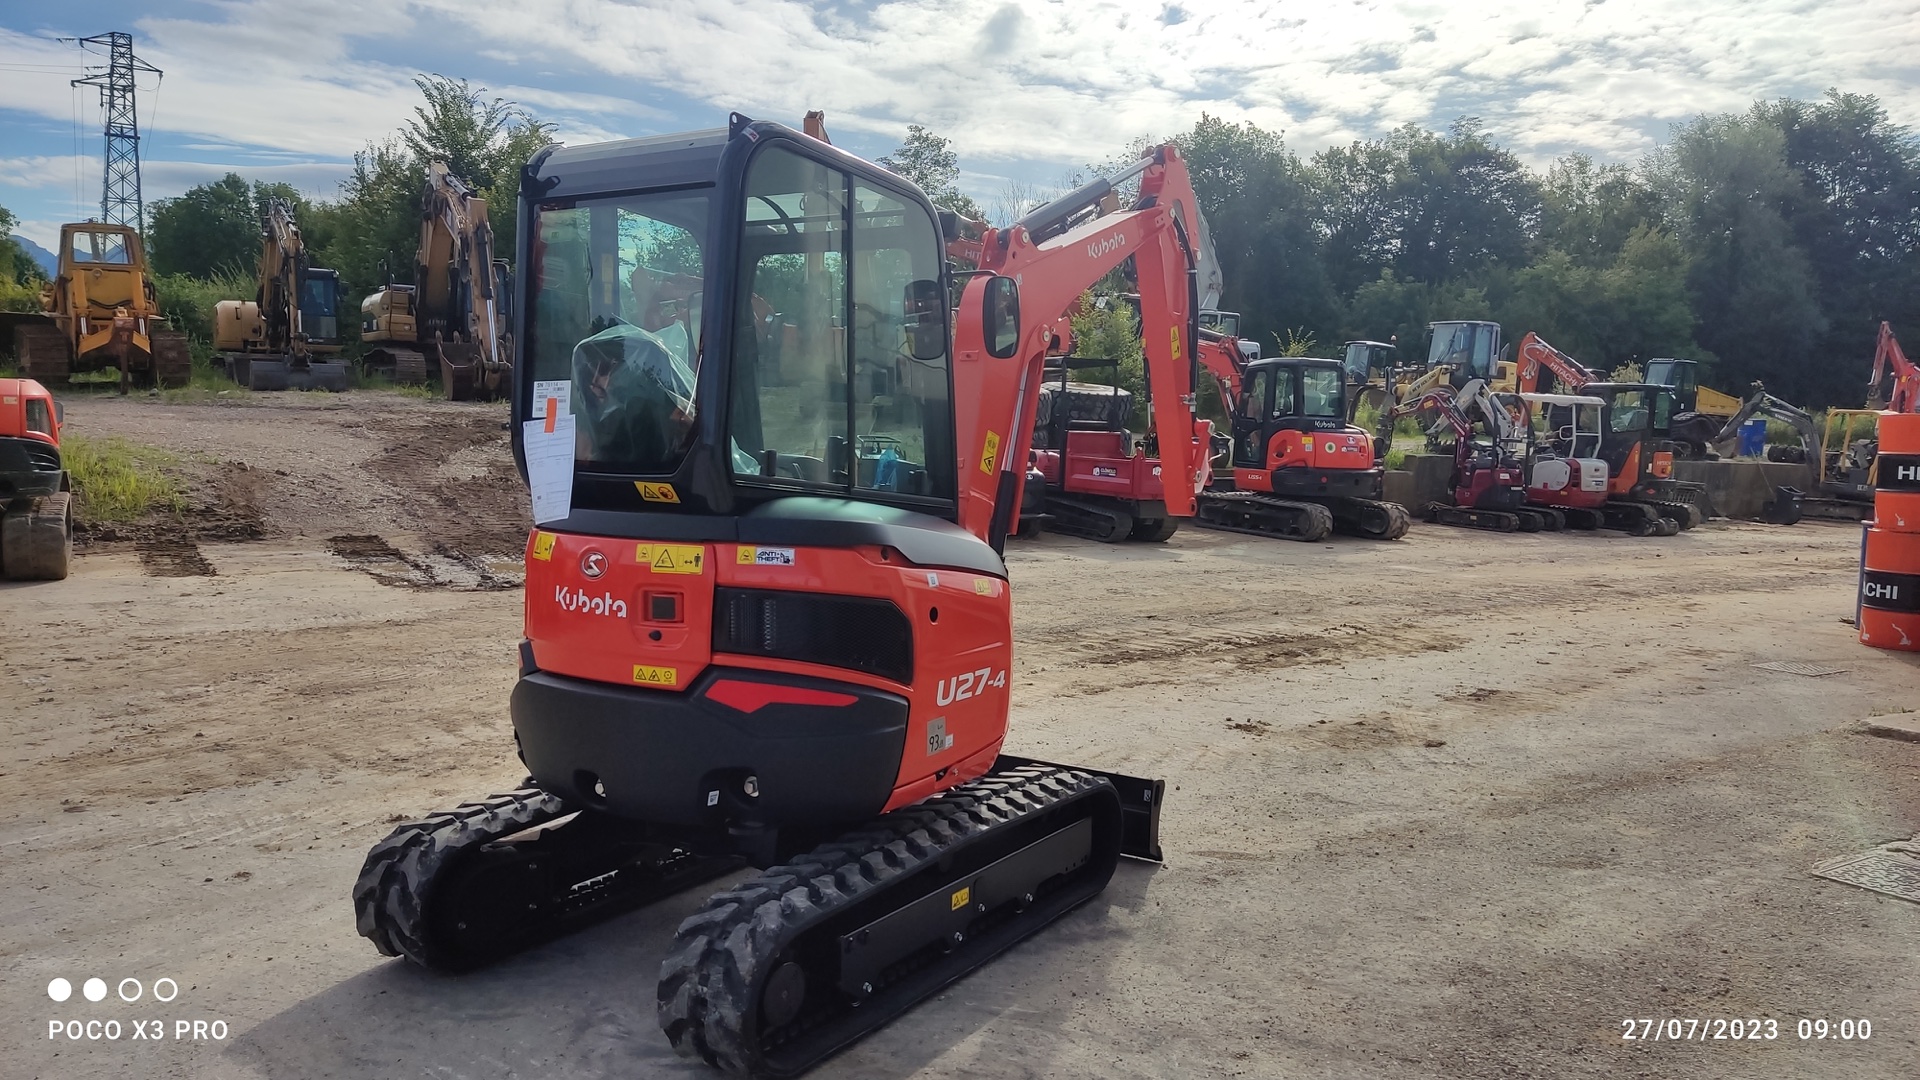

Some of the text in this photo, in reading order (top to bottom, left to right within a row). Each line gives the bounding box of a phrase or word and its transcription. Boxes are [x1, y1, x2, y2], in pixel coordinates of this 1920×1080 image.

[1087, 232, 1126, 259] Kubota
[1550, 362, 1578, 387] HITACHI
[1314, 420, 1336, 429] Kubota
[555, 585, 627, 618] Kubota
[936, 667, 1006, 707] U27-4
